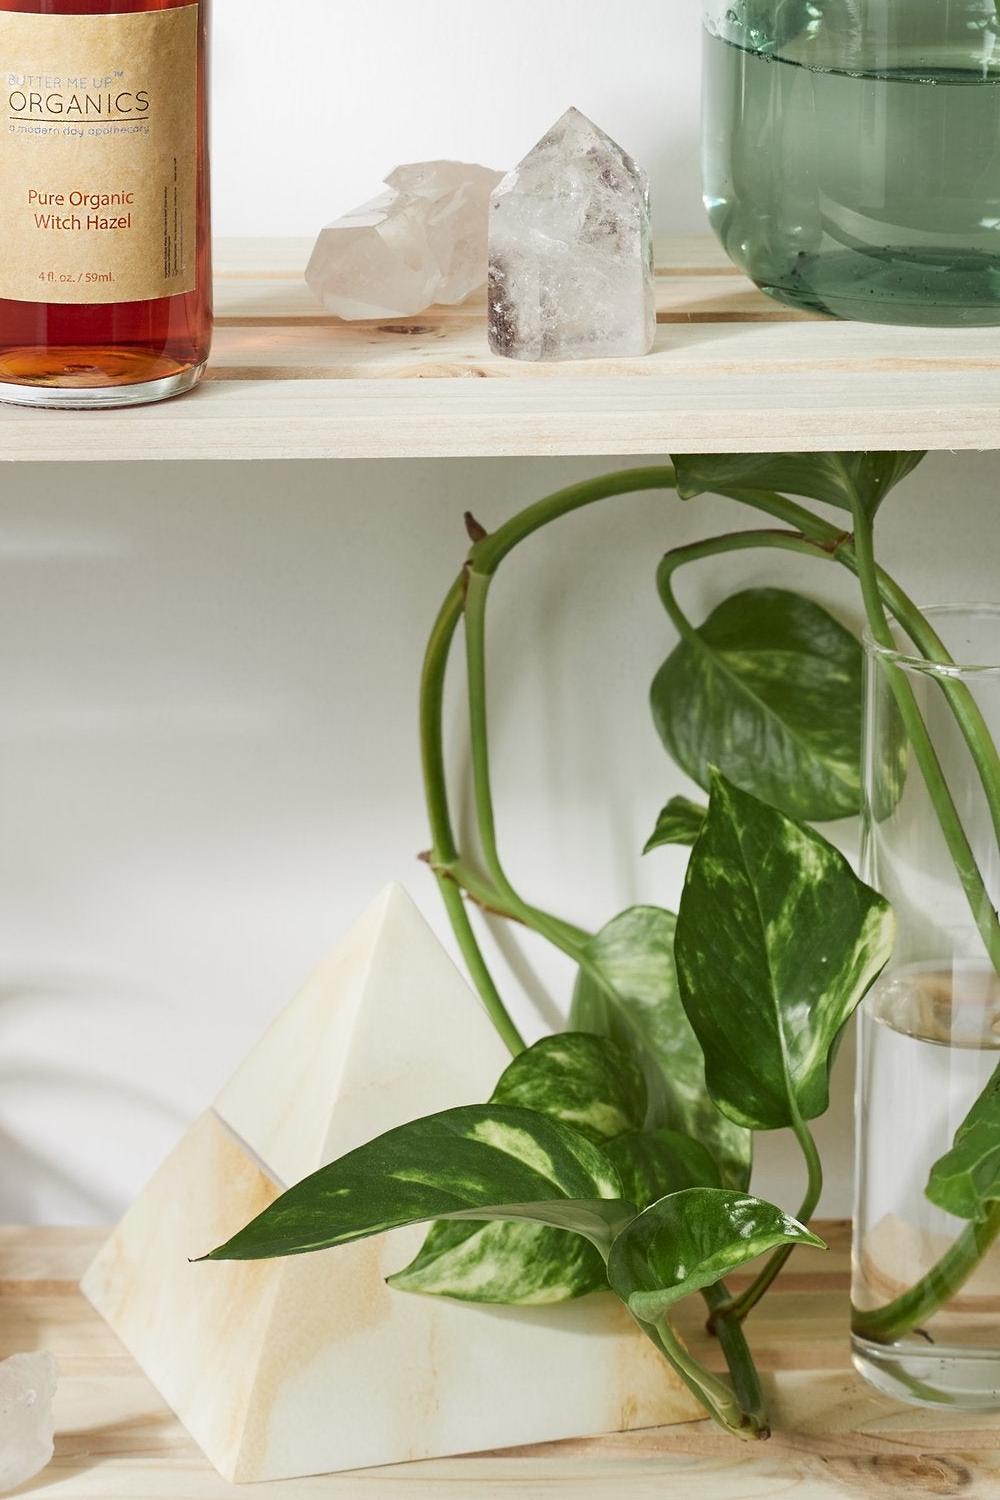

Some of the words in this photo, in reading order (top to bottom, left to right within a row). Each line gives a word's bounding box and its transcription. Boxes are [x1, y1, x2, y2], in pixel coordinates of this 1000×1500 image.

[8, 74, 62, 89] BUTTER
[67, 76, 87, 89] ME
[9, 91, 149, 114] ORGANICS
[18, 125, 60, 135] modern
[63, 125, 85, 137] day
[88, 124, 150, 137] apothecary
[28, 189, 65, 206] Pure
[69, 190, 134, 210] Organic
[34, 213, 81, 230] Witch
[86, 212, 131, 230] Hazel
[38, 271, 45, 282] 4
